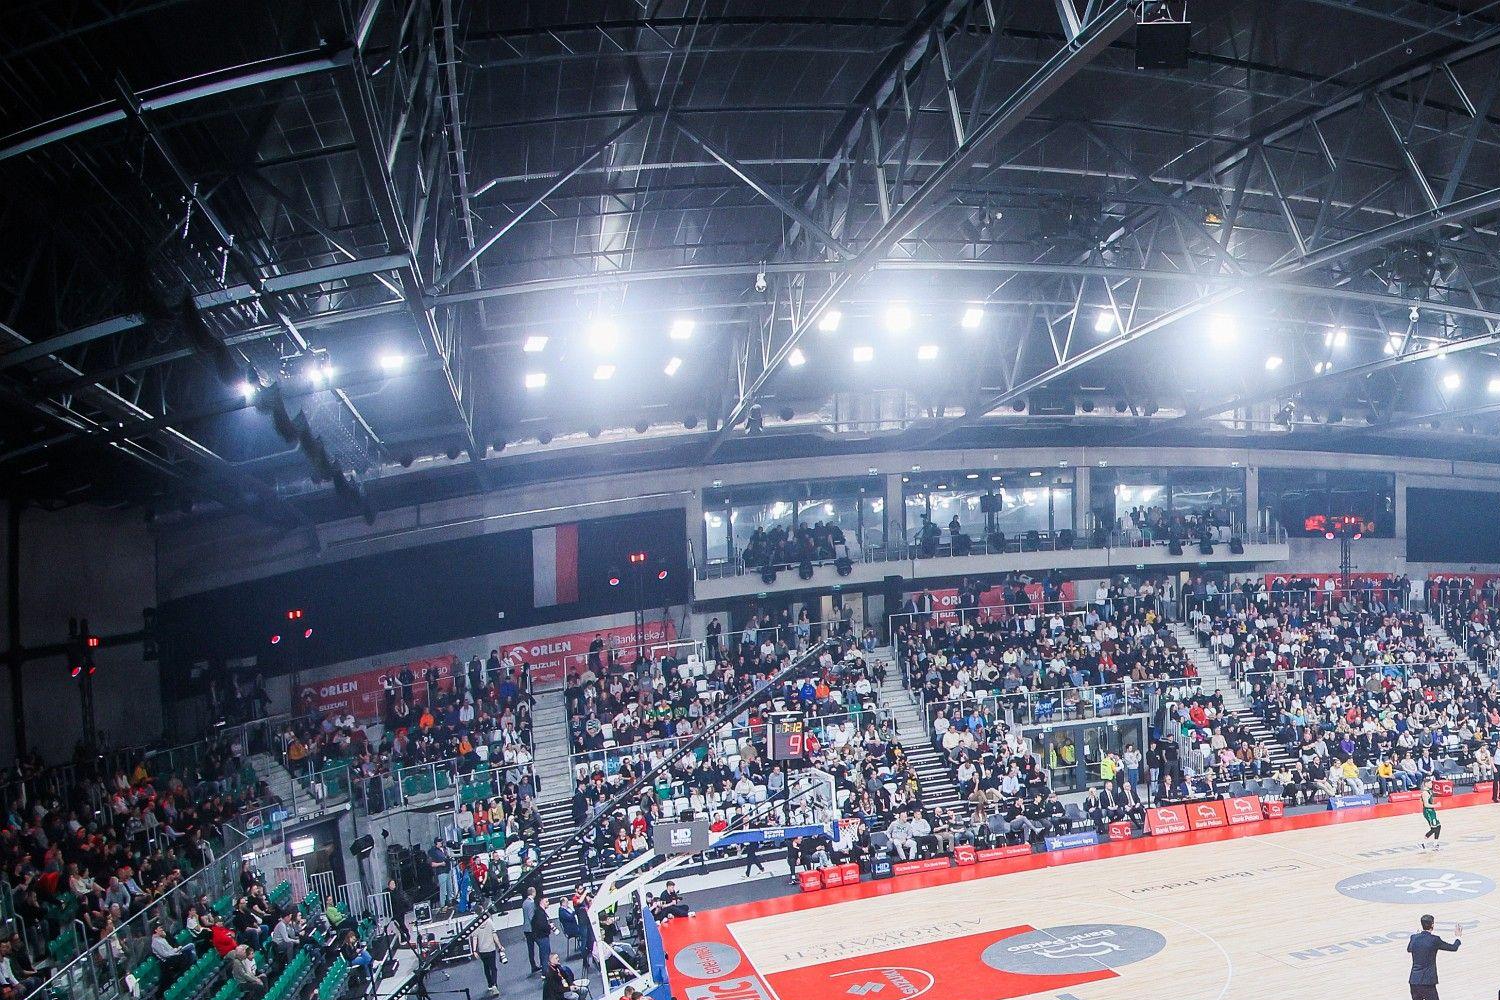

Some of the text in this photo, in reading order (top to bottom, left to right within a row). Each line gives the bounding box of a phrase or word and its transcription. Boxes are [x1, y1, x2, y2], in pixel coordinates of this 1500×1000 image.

[530, 641, 572, 657] ORLEN
[530, 660, 560, 671] SUZUKI
[320, 681, 358, 698] ORLEN
[318, 701, 348, 712] SUZUKI
[782, 721, 802, 733] 7:12
[789, 734, 802, 755] 9
[670, 829, 692, 840] HID
[1007, 929, 1117, 952] Bank Pekao
[1289, 930, 1410, 961] ORLEN
